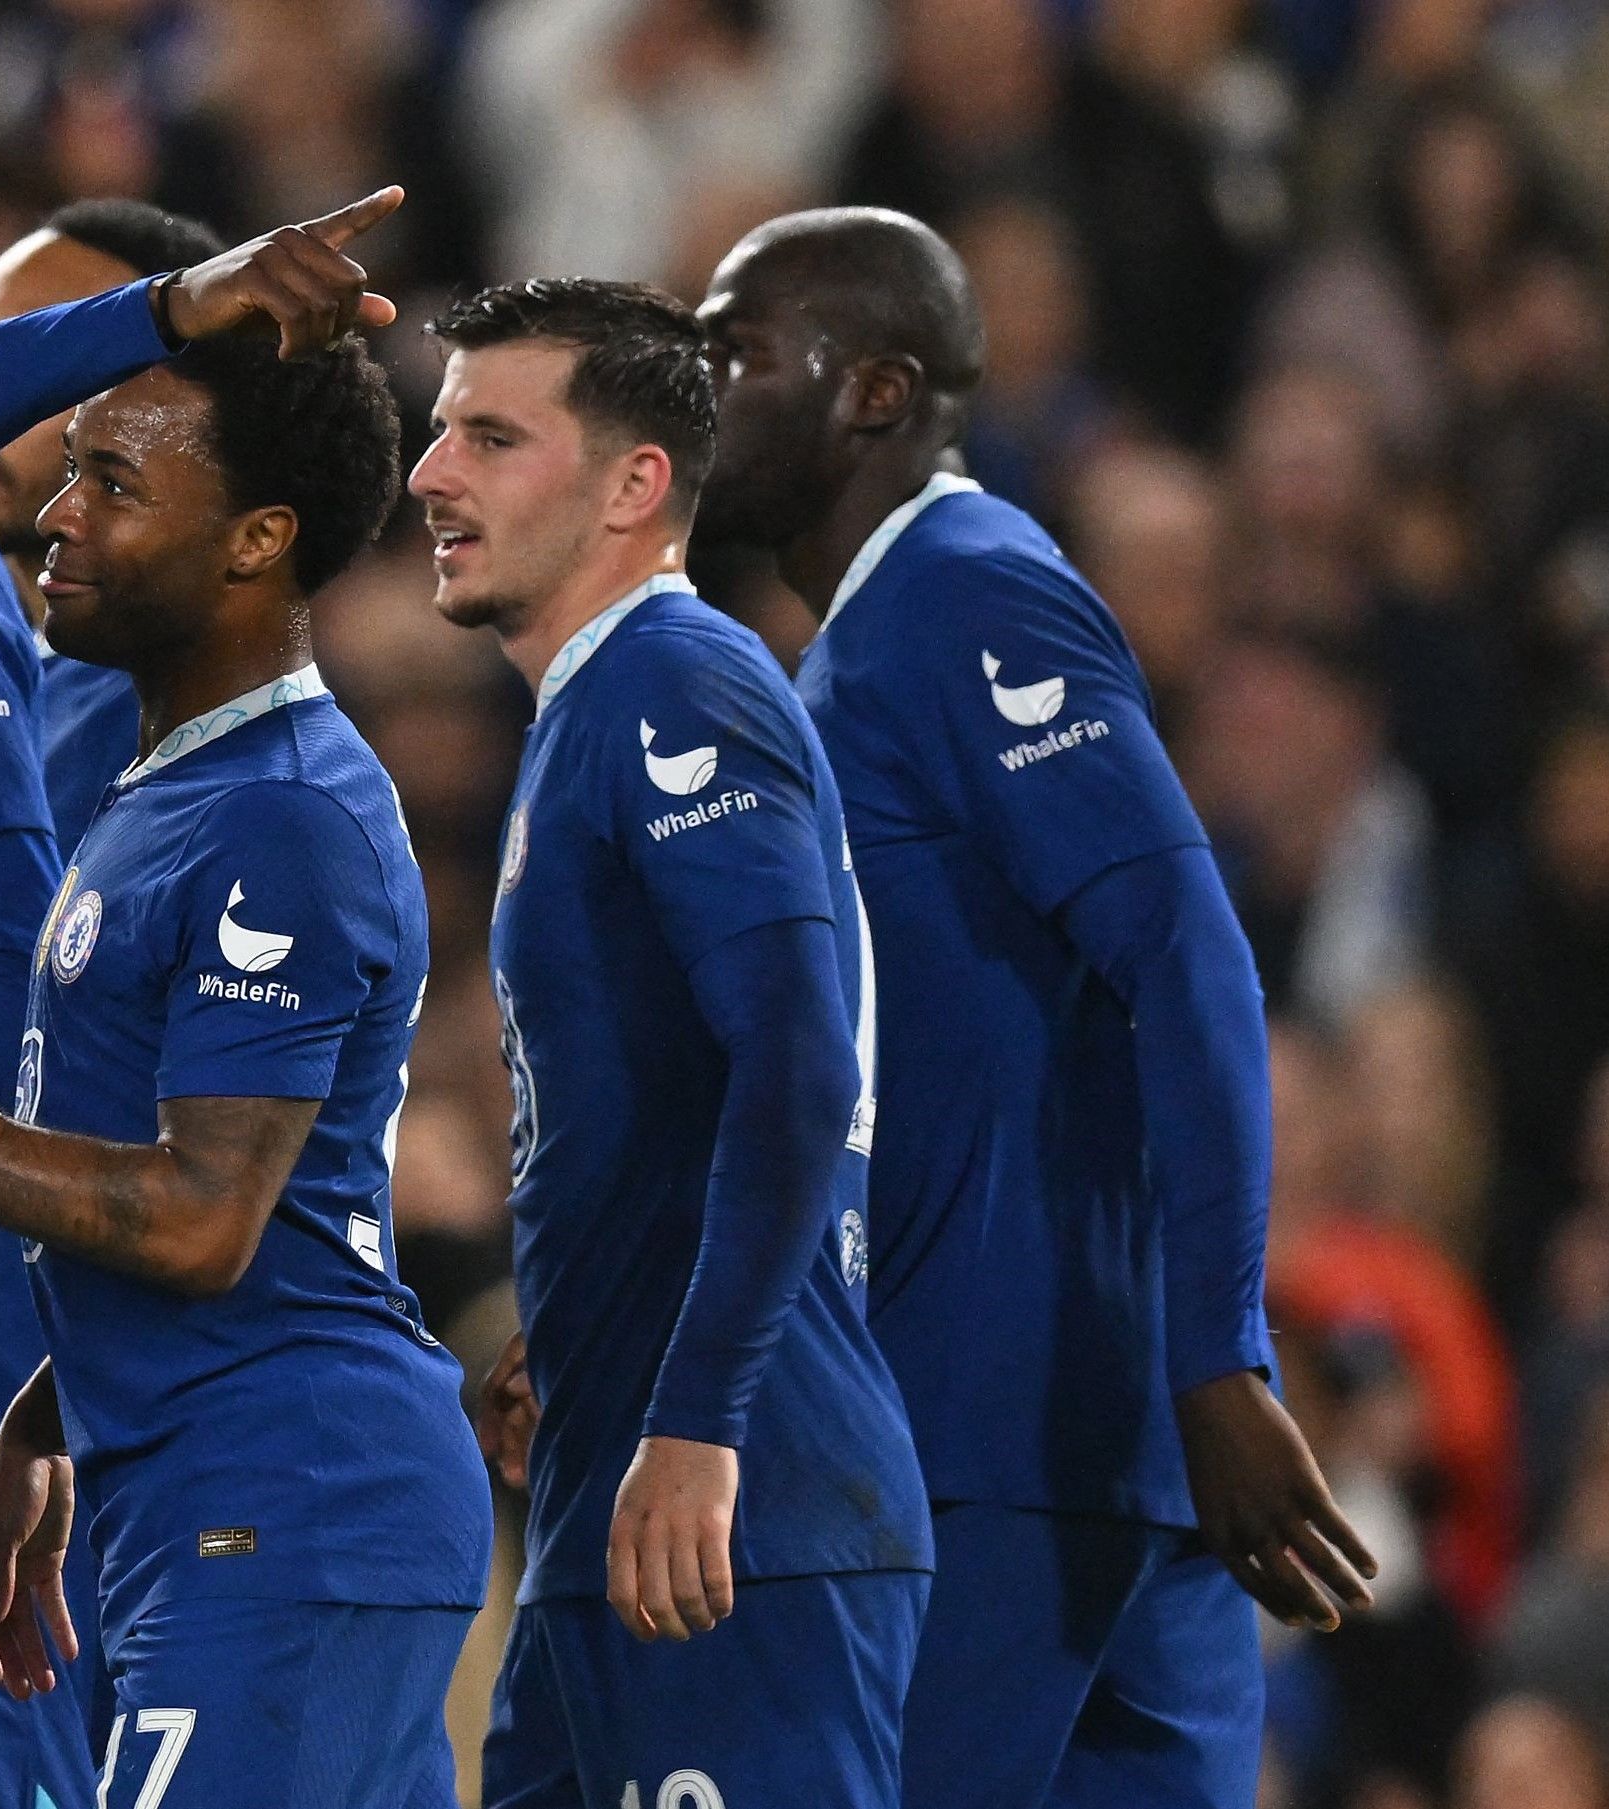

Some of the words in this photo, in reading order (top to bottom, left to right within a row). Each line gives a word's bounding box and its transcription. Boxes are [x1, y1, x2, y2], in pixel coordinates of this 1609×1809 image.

[999, 717, 1109, 772] WhaleFin
[647, 789, 757, 842] WhaleFin
[198, 974, 300, 1011] WhaleFin
